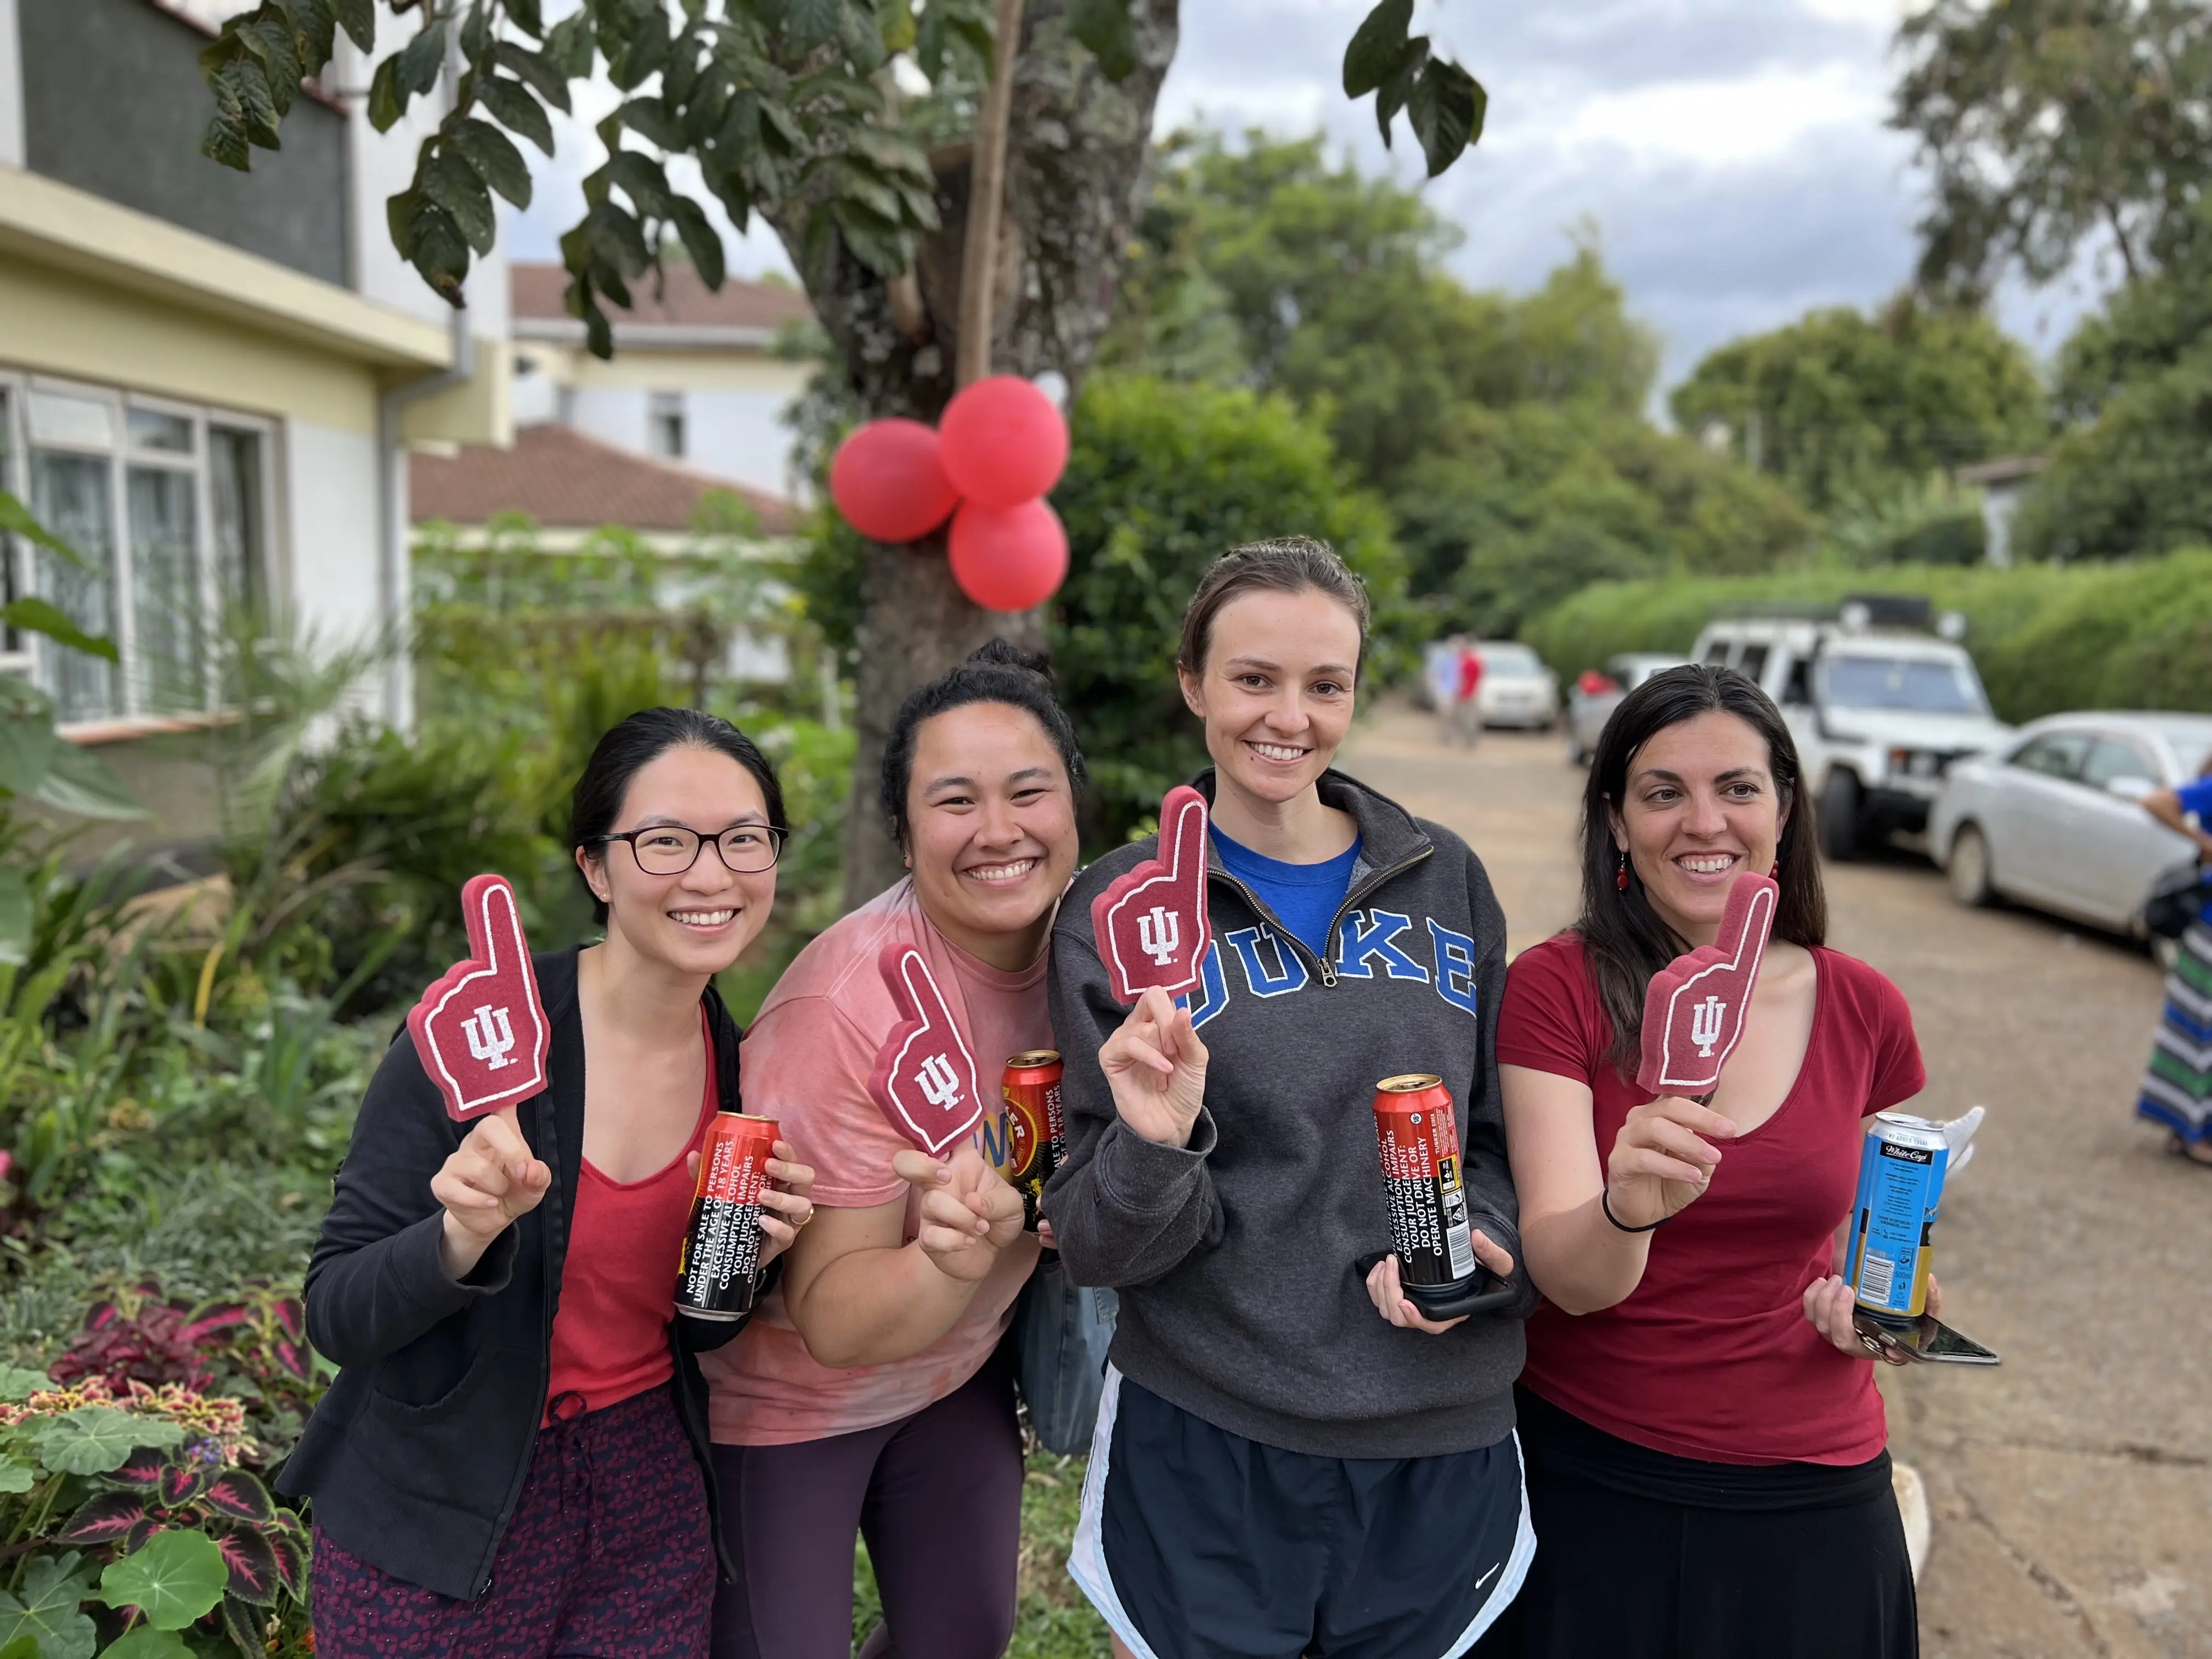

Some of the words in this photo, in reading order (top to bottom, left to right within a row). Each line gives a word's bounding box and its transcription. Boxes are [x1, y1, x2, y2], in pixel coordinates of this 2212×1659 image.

[1046, 1089, 1058, 1133] PERSONS
[1057, 1116, 1064, 1127] 18
[1051, 1135, 1059, 1150] TO
[1059, 1131, 1066, 1144] OF
[1381, 1138, 1394, 1193] ALCOHOL
[1386, 1130, 1400, 1175] IMPAIRS
[1408, 1147, 1418, 1163] OR
[708, 1142, 724, 1192] PERSONS
[1397, 1145, 1417, 1216] JUDGEMENT:
[1417, 1137, 1435, 1204] MACHINERY
[717, 1177, 726, 1189] 18
[759, 1174, 768, 1190] OR
[1410, 1166, 1424, 1199] DRIVE
[703, 1195, 713, 1210] TO
[713, 1193, 723, 1209] OF
[1415, 1201, 1427, 1227] NOT
[698, 1214, 709, 1240] SALE
[708, 1212, 720, 1235] AGE
[711, 1220, 730, 1278] EXCESSIVE
[724, 1164, 742, 1218] ALCOHOL
[719, 1204, 744, 1290] CONSUMPTION
[737, 1155, 754, 1200] IMPAIRS
[732, 1244, 746, 1276] YOUR
[740, 1171, 760, 1242] JUDGEMENT:
[1389, 1195, 1403, 1252] EXCESSIVE
[1393, 1178, 1412, 1263] CONSUMPTION
[1408, 1218, 1420, 1250] YOUR
[1427, 1206, 1443, 1256] OPERATE
[702, 1237, 715, 1259] THE
[746, 1228, 756, 1254] NOT
[1420, 1229, 1431, 1248] DO
[692, 1243, 703, 1266] FOR
[742, 1256, 751, 1274] DO
[747, 1235, 762, 1284] OPERATE
[686, 1267, 698, 1294] NOT
[693, 1262, 709, 1302] UNDER
